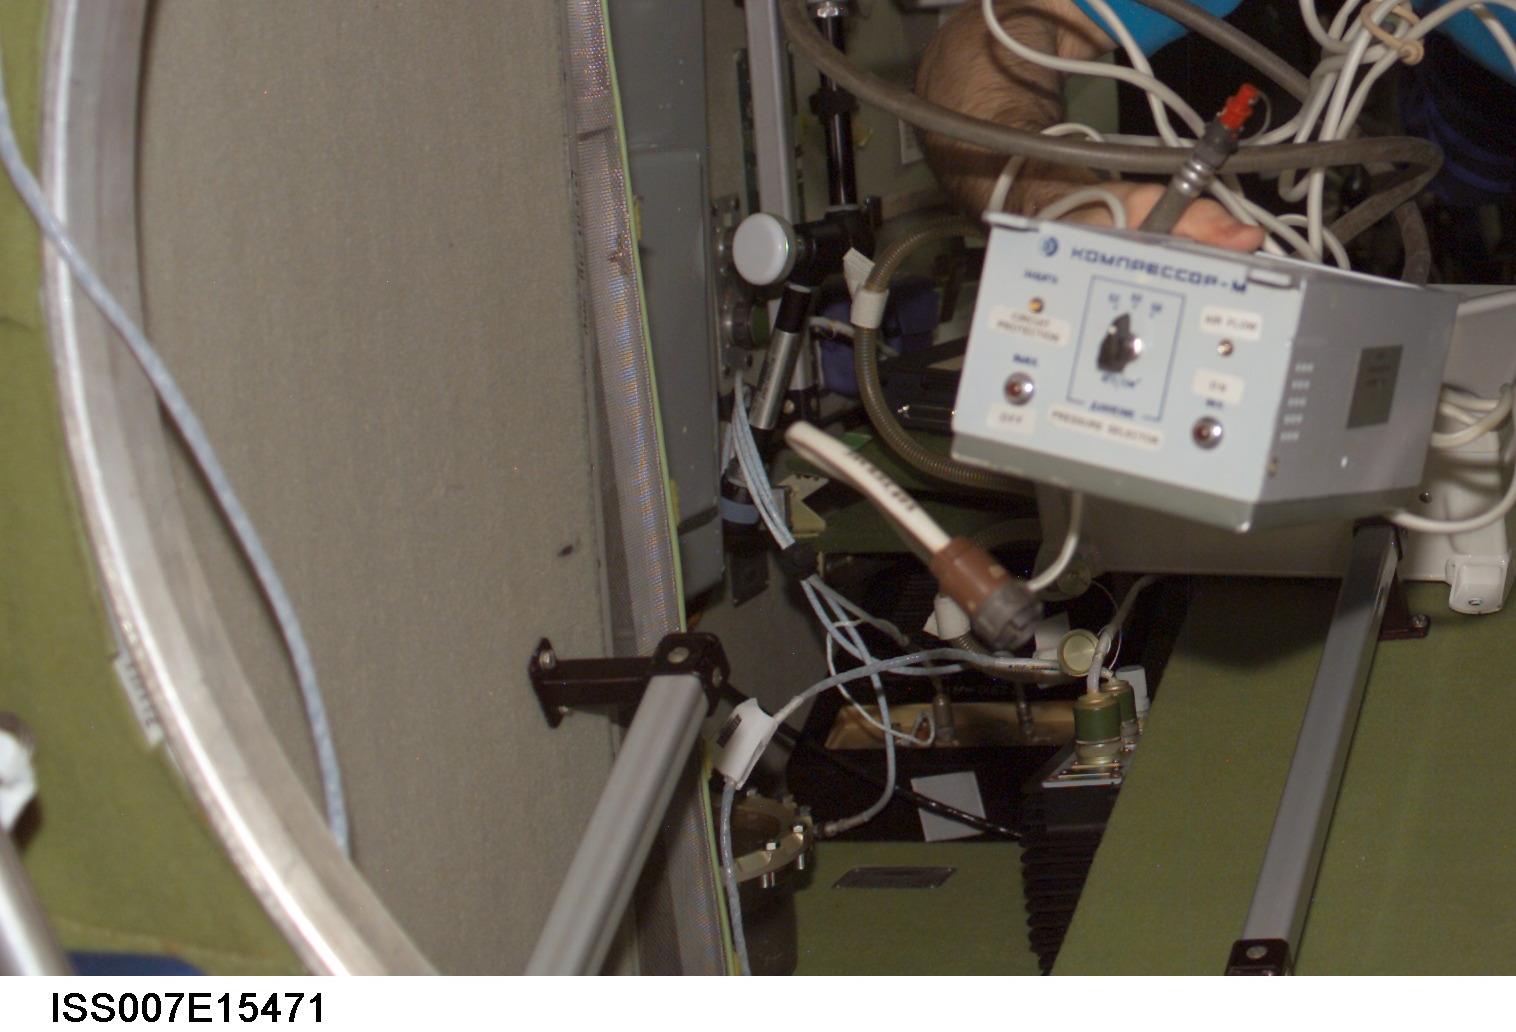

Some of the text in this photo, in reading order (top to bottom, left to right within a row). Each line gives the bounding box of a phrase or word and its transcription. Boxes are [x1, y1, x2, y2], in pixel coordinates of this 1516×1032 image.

[996, 319, 1060, 342] PROTECTION
[1052, 409, 1160, 447] PRESSURE SELECTOR
